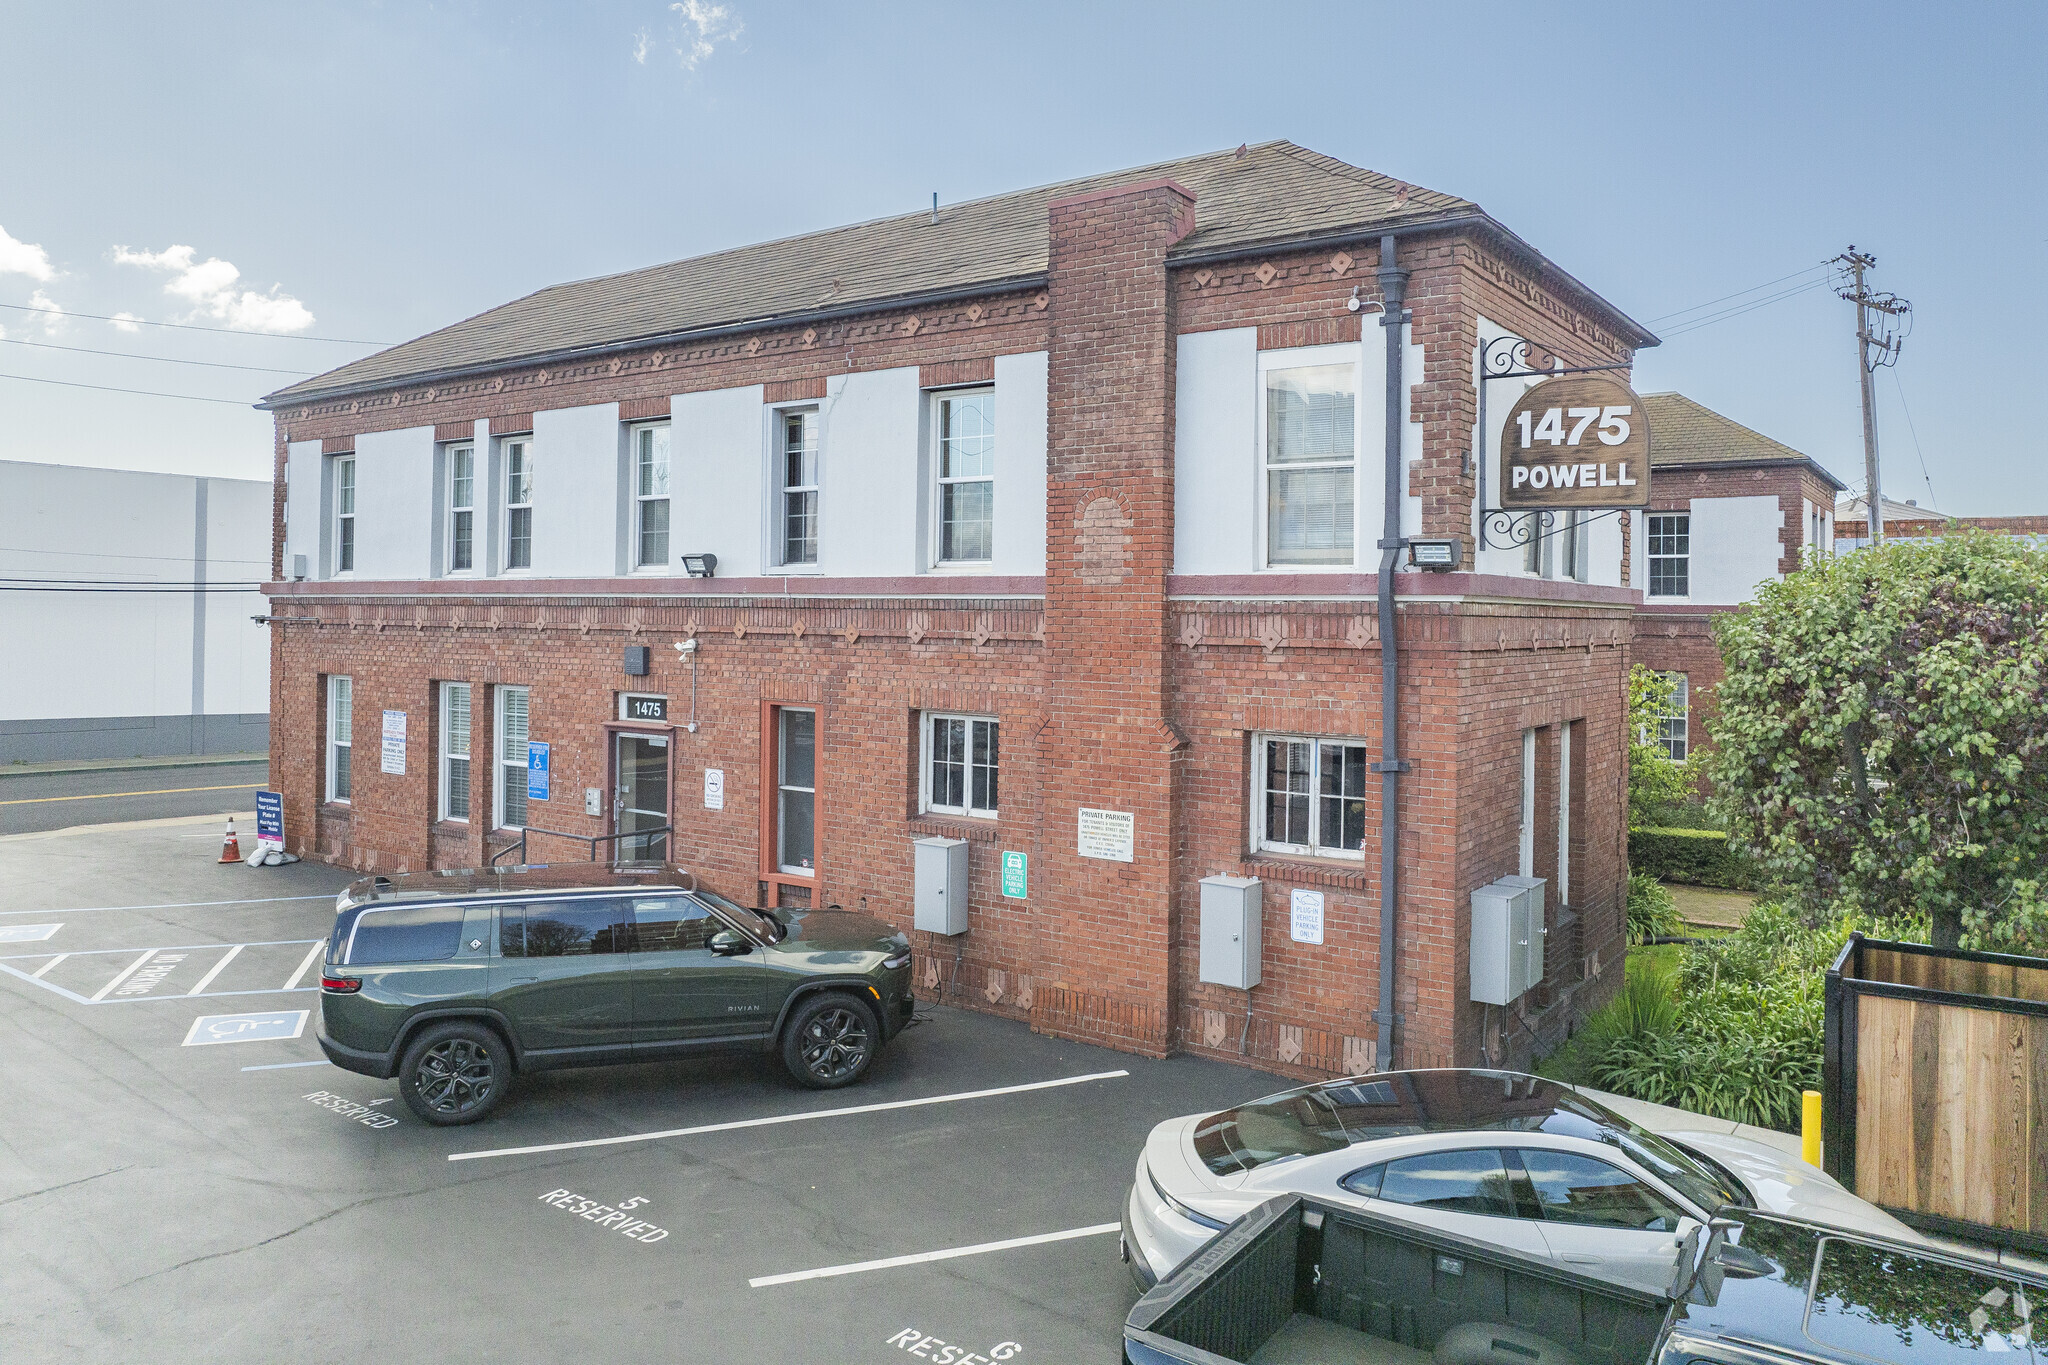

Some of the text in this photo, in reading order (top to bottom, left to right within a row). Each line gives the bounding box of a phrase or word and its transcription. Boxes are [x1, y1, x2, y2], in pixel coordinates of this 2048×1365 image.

[1516, 405, 1632, 448] 1475
[1512, 463, 1637, 489] POWELL
[635, 701, 661, 717] 1475
[259, 796, 278, 804] Remember
[1081, 811, 1131, 822] PRIVATE PARKING
[1005, 868, 1024, 876] ELECTRIC
[1006, 874, 1023, 882] VEHICLE
[1005, 880, 1023, 888] PARKING
[1296, 906, 1318, 914] PLUG-IN
[1296, 914, 1318, 922] VEHICLE
[1296, 922, 1318, 930] PARKING
[1300, 930, 1314, 938] ONLY
[115, 965, 176, 995] PARKING
[368, 1098, 393, 1107] 4
[301, 1090, 399, 1128] RESERVED
[618, 1196, 651, 1210] 5
[538, 1188, 669, 1243] RESERVED
[989, 1341, 1022, 1360] 6
